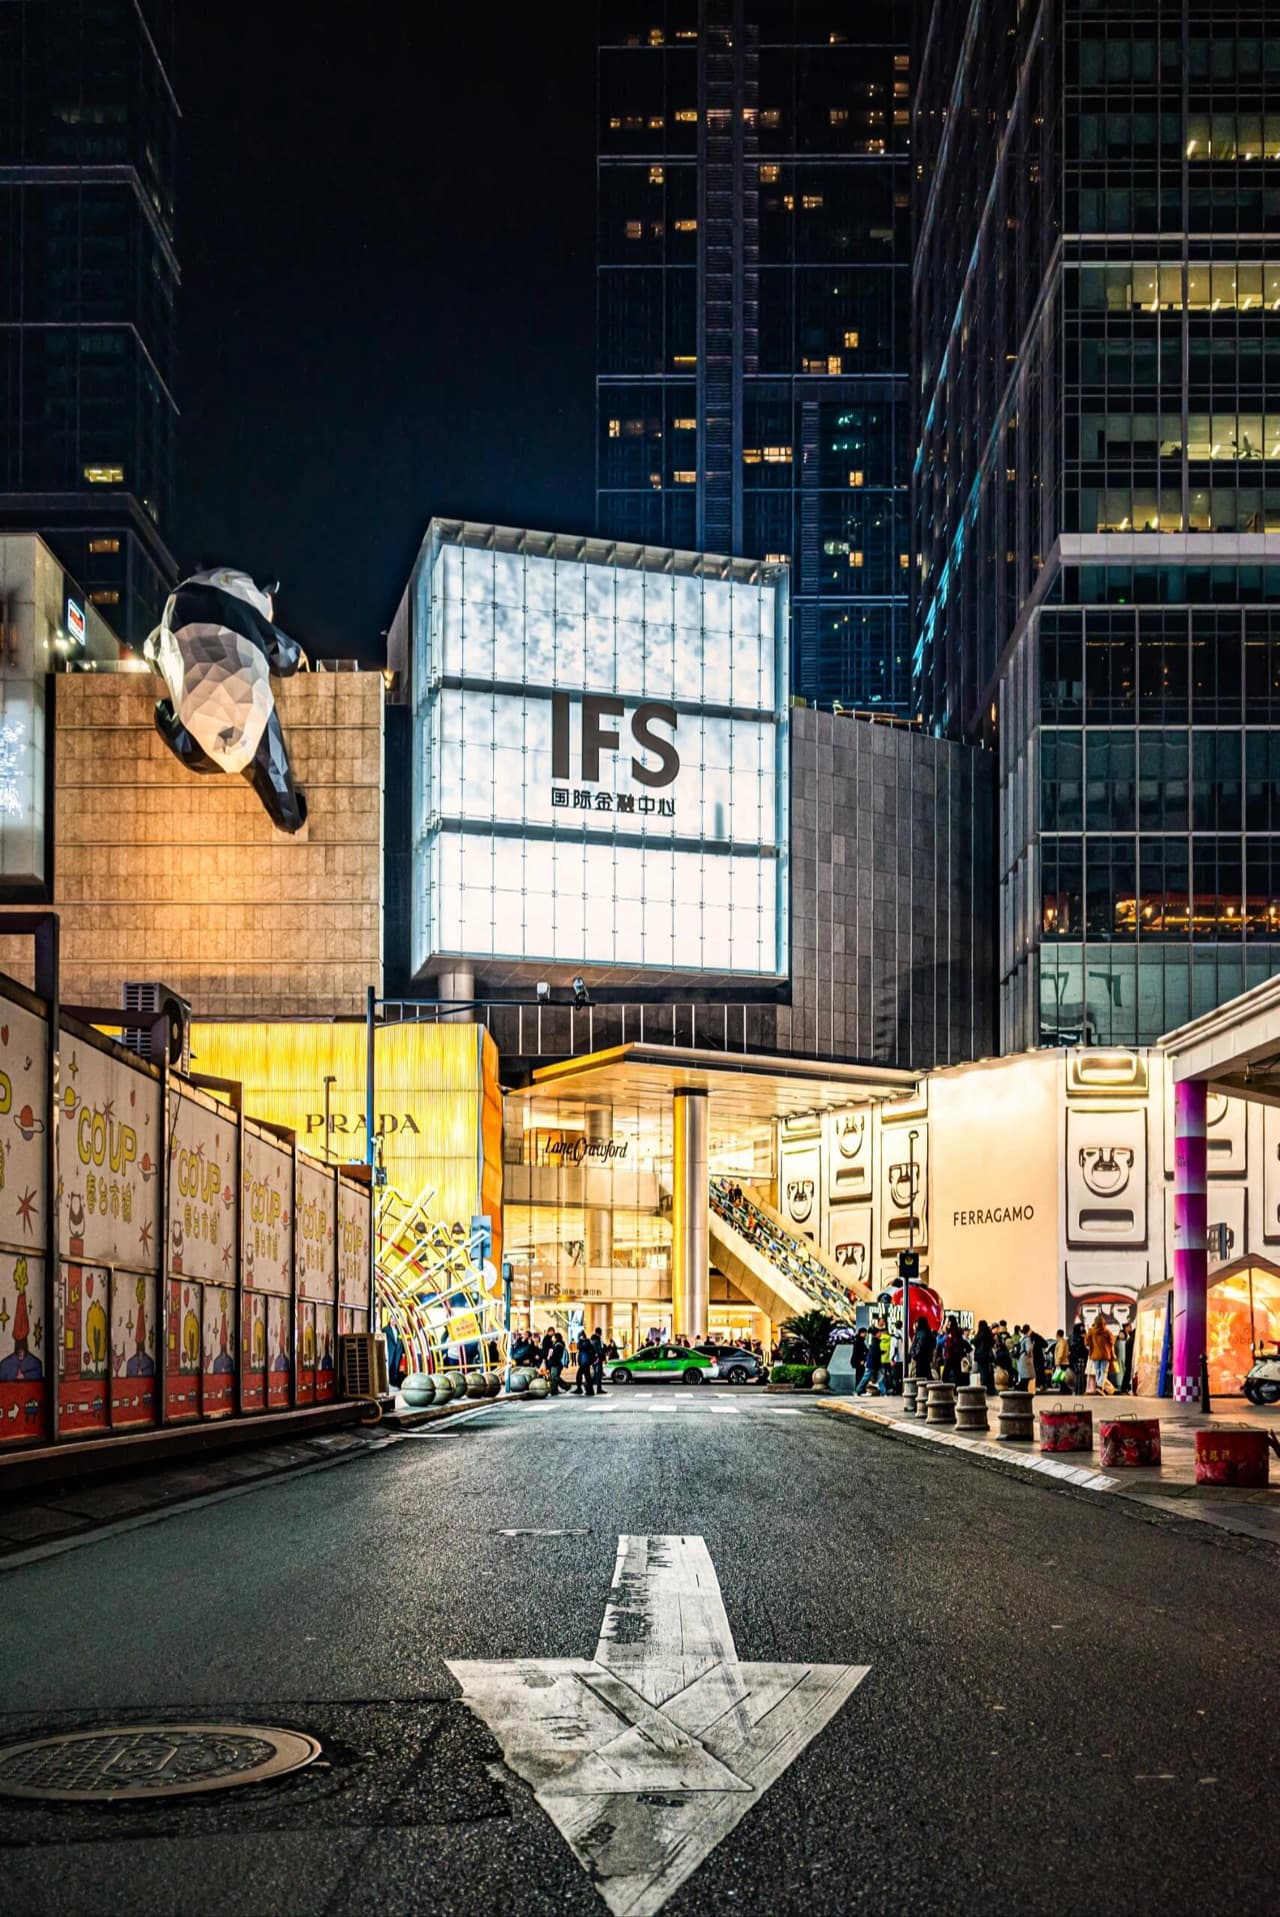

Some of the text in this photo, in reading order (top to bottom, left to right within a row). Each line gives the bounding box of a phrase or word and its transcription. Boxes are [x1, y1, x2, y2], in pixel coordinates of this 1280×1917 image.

[552, 691, 680, 788] IFS
[551, 787, 676, 817] 国际金融中心
[305, 1113, 420, 1134] PRADA
[77, 1106, 137, 1177] COUP
[545, 1136, 628, 1167] Lane Crawford
[953, 1204, 1034, 1227] FERRAGAMO
[544, 1282, 561, 1296] IFS
